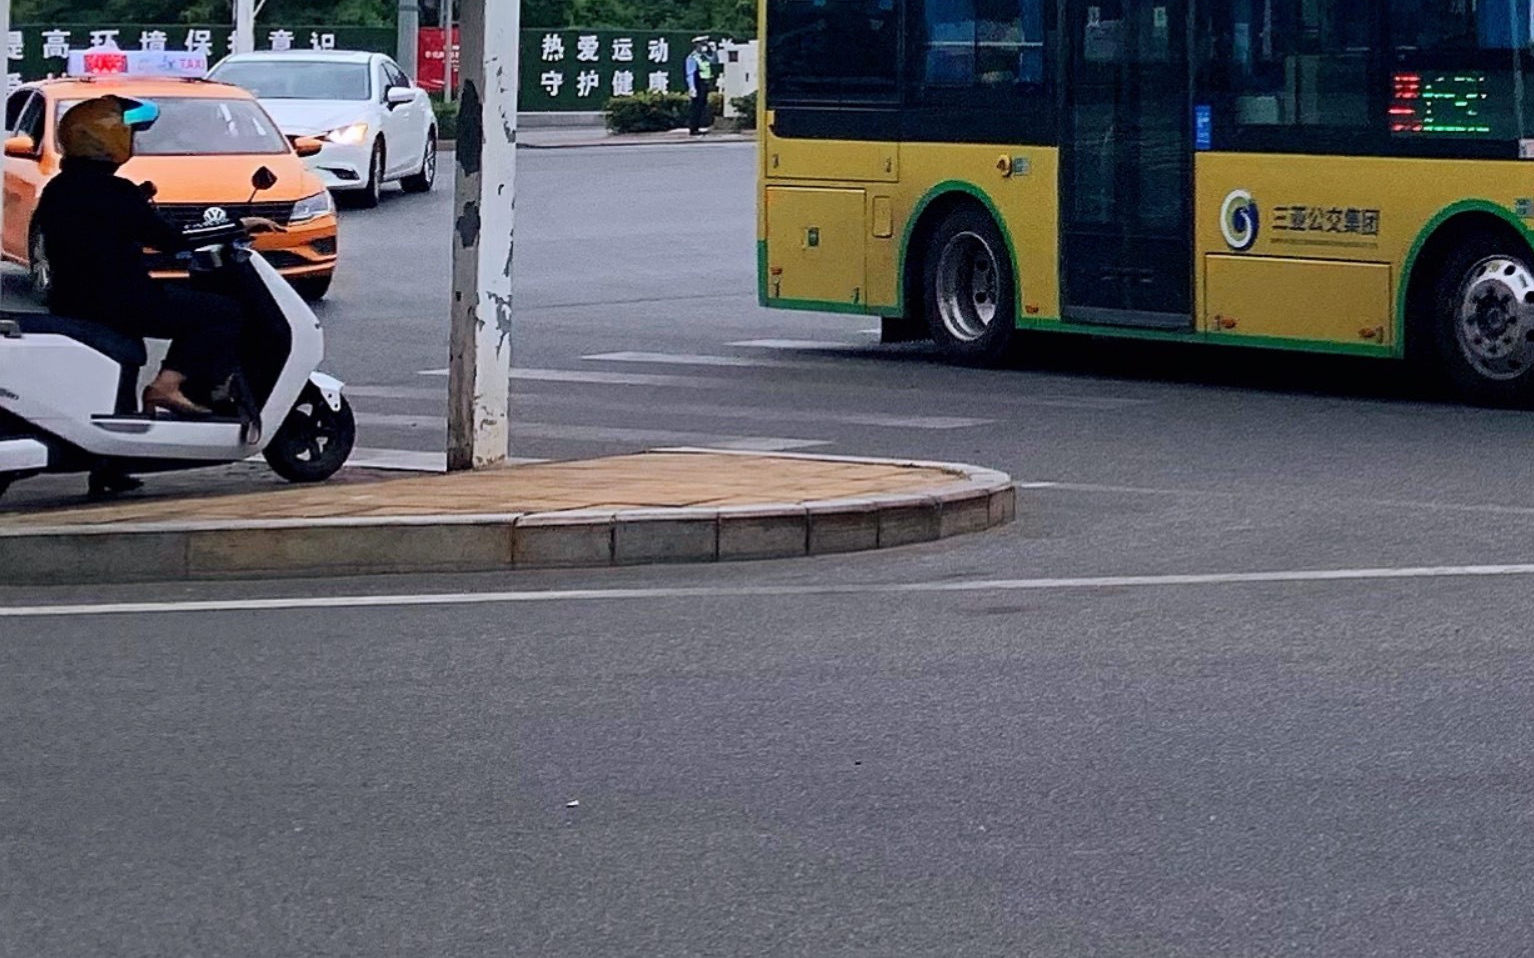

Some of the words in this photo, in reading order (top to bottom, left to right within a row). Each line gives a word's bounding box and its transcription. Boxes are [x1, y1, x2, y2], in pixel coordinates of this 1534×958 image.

[540, 33, 669, 63] 热爱运动
[178, 58, 205, 70] TAXI
[540, 69, 669, 98] 守护健康
[1271, 205, 1381, 236] 三亚公交集团
